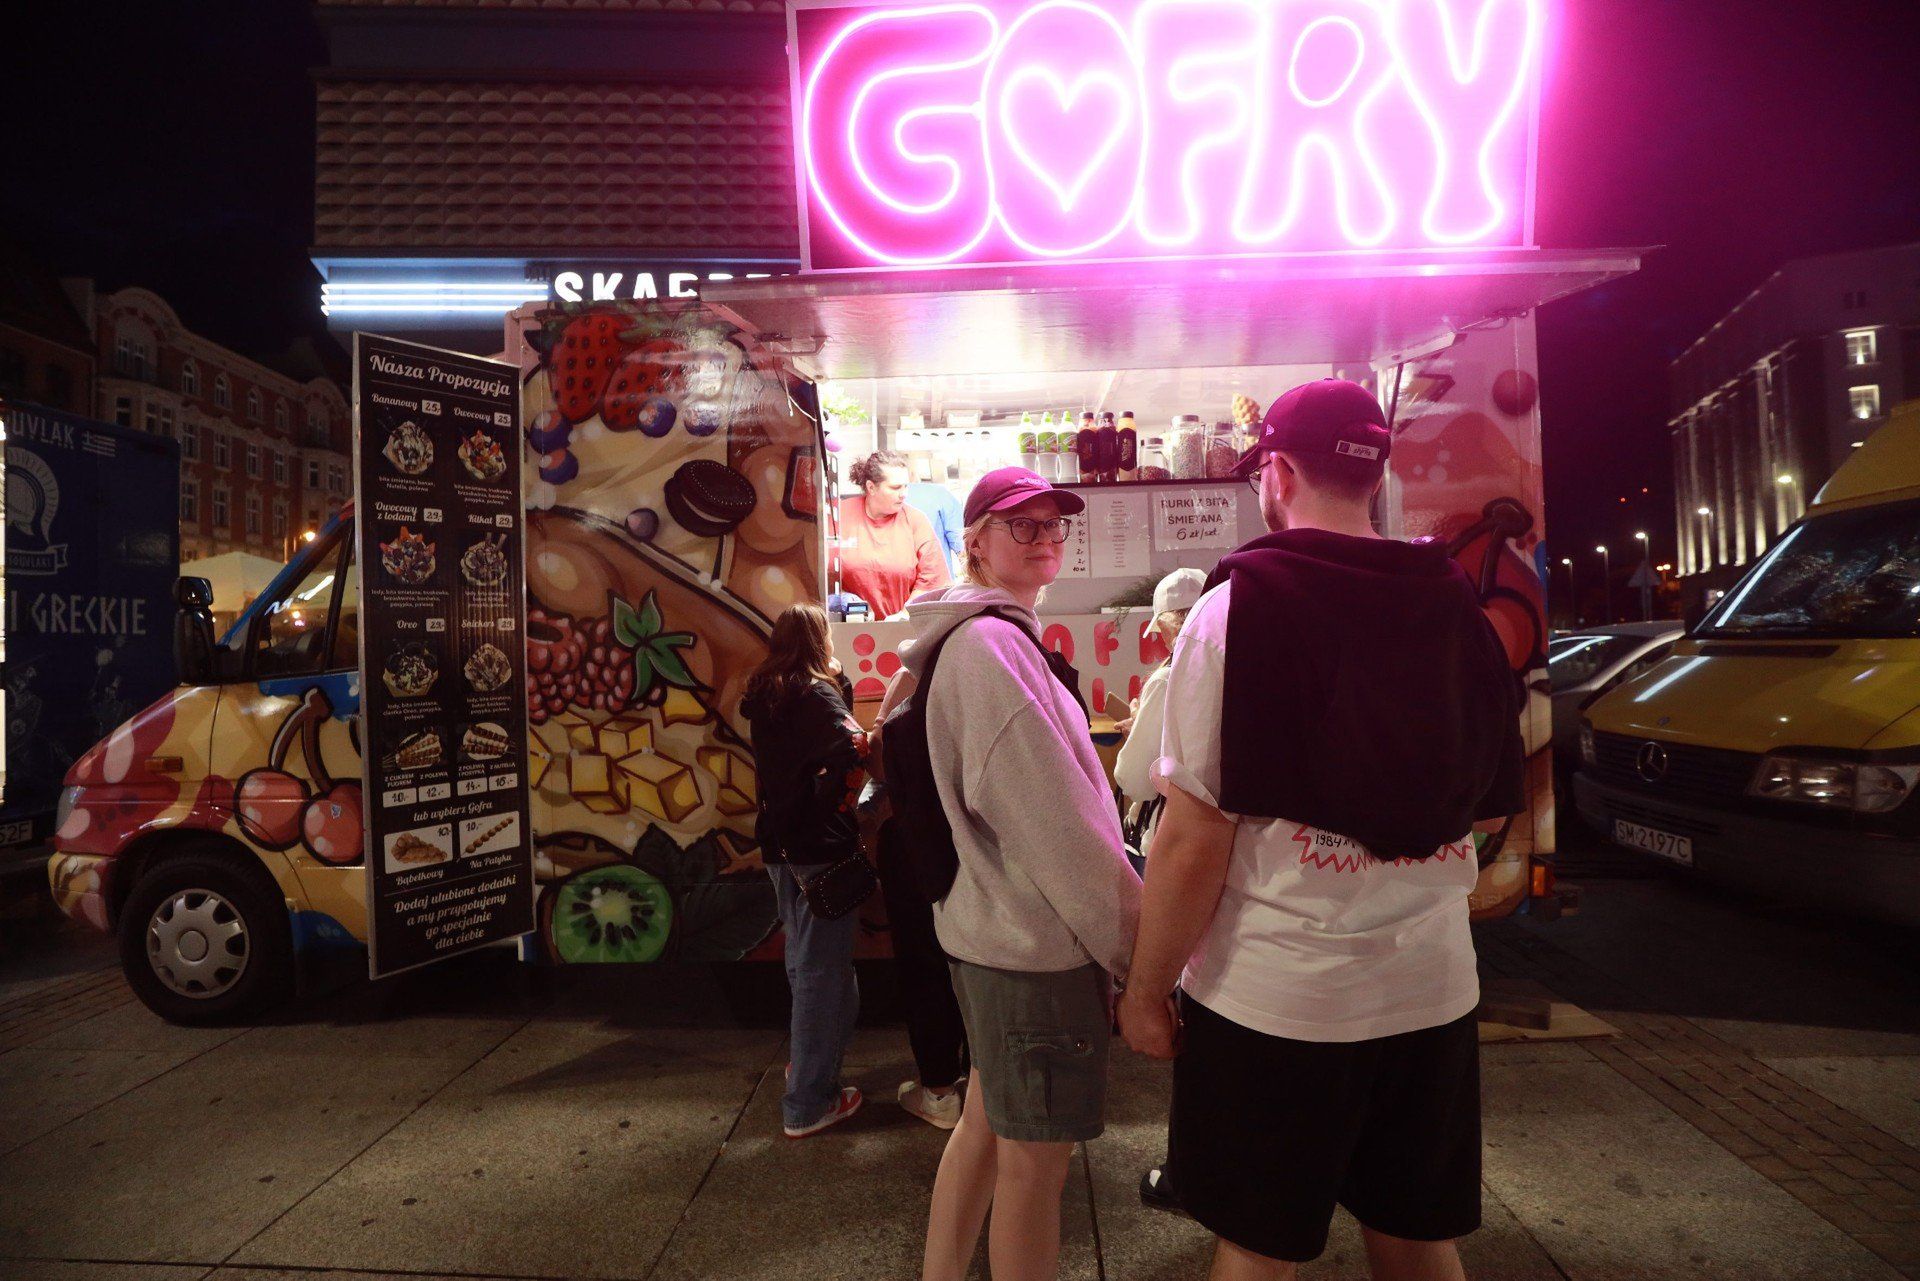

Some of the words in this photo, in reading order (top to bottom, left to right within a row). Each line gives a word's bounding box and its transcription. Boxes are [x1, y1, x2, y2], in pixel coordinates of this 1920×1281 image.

[369, 354, 425, 380] Nasza
[428, 366, 511, 398] Propozycja
[371, 393, 418, 411] Bananowy
[453, 407, 491, 422] Owocowy
[375, 502, 418, 516] Owocowy
[384, 511, 417, 522] lodami
[1176, 528, 1187, 541] 6
[31, 592, 146, 635] GRECKIE
[396, 620, 418, 629] Oreo
[461, 619, 495, 629] Snickers
[389, 773, 414, 781] CUKREM
[413, 810, 429, 822] lub
[431, 805, 467, 823] wybierz
[468, 801, 493, 815] Gofra
[1315, 833, 1342, 848] 1984
[1639, 829, 1688, 858] 2197C
[470, 859, 482, 869] Na
[484, 855, 513, 869] Patyku
[395, 869, 444, 887] Bąbelkowy
[394, 897, 430, 914] Dodaj
[432, 886, 475, 905] ulubione
[478, 875, 517, 893] dodatki
[407, 917, 415, 926] a
[417, 913, 435, 925] my
[437, 893, 507, 921] przygotujemy
[425, 927, 440, 940] go
[441, 912, 492, 933] specjalnie
[435, 936, 454, 950] dla
[456, 929, 485, 944] ciebie
